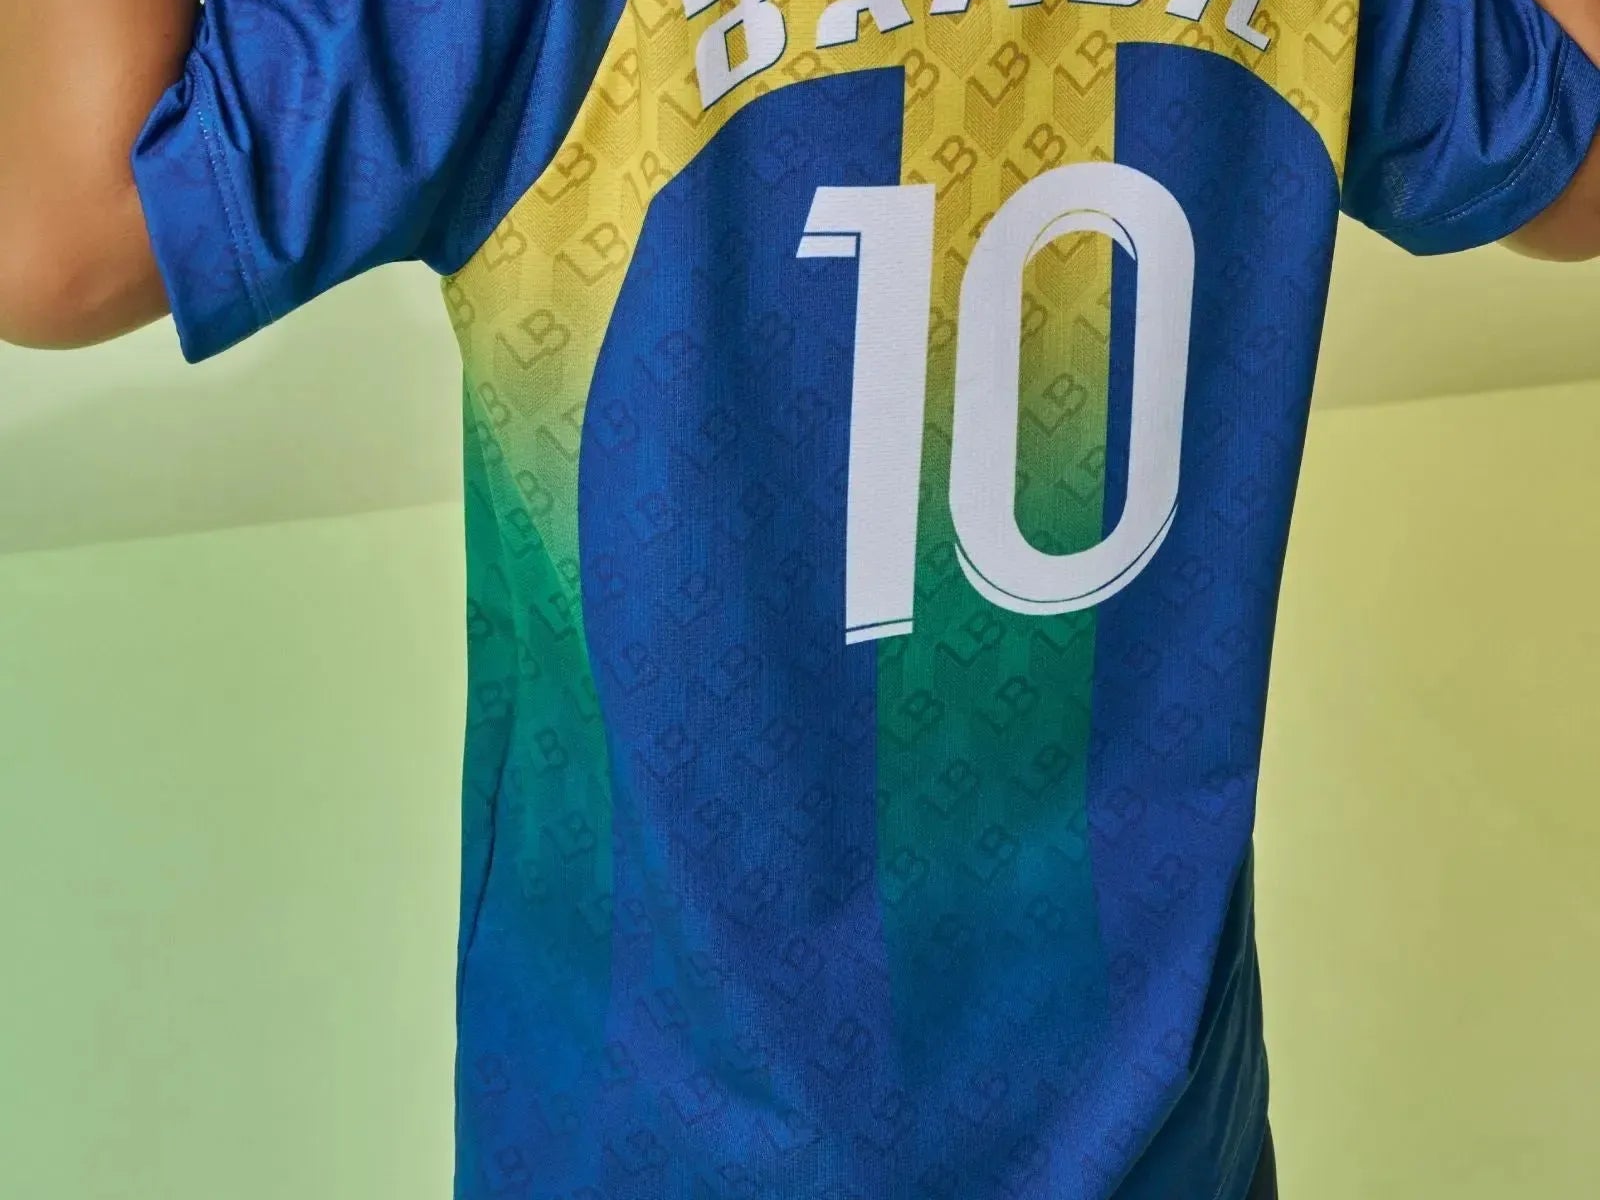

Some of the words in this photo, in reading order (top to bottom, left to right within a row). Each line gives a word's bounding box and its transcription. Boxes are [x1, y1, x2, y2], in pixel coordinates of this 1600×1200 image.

[1053, 30, 1117, 96] LB
[1305, 0, 1360, 63] LB
[593, 47, 642, 115] LB
[965, 39, 1032, 109] LB
[535, 141, 598, 206] LB
[553, 222, 631, 287] LB
[495, 308, 571, 371] LB
[796, 161, 1196, 646] 10
[1022, 372, 1089, 438] LB
[936, 609, 1007, 668] LB
[973, 675, 1041, 736] LB
[917, 758, 984, 819] LB
[1010, 742, 1075, 801] LB
[957, 823, 1020, 886] LB
